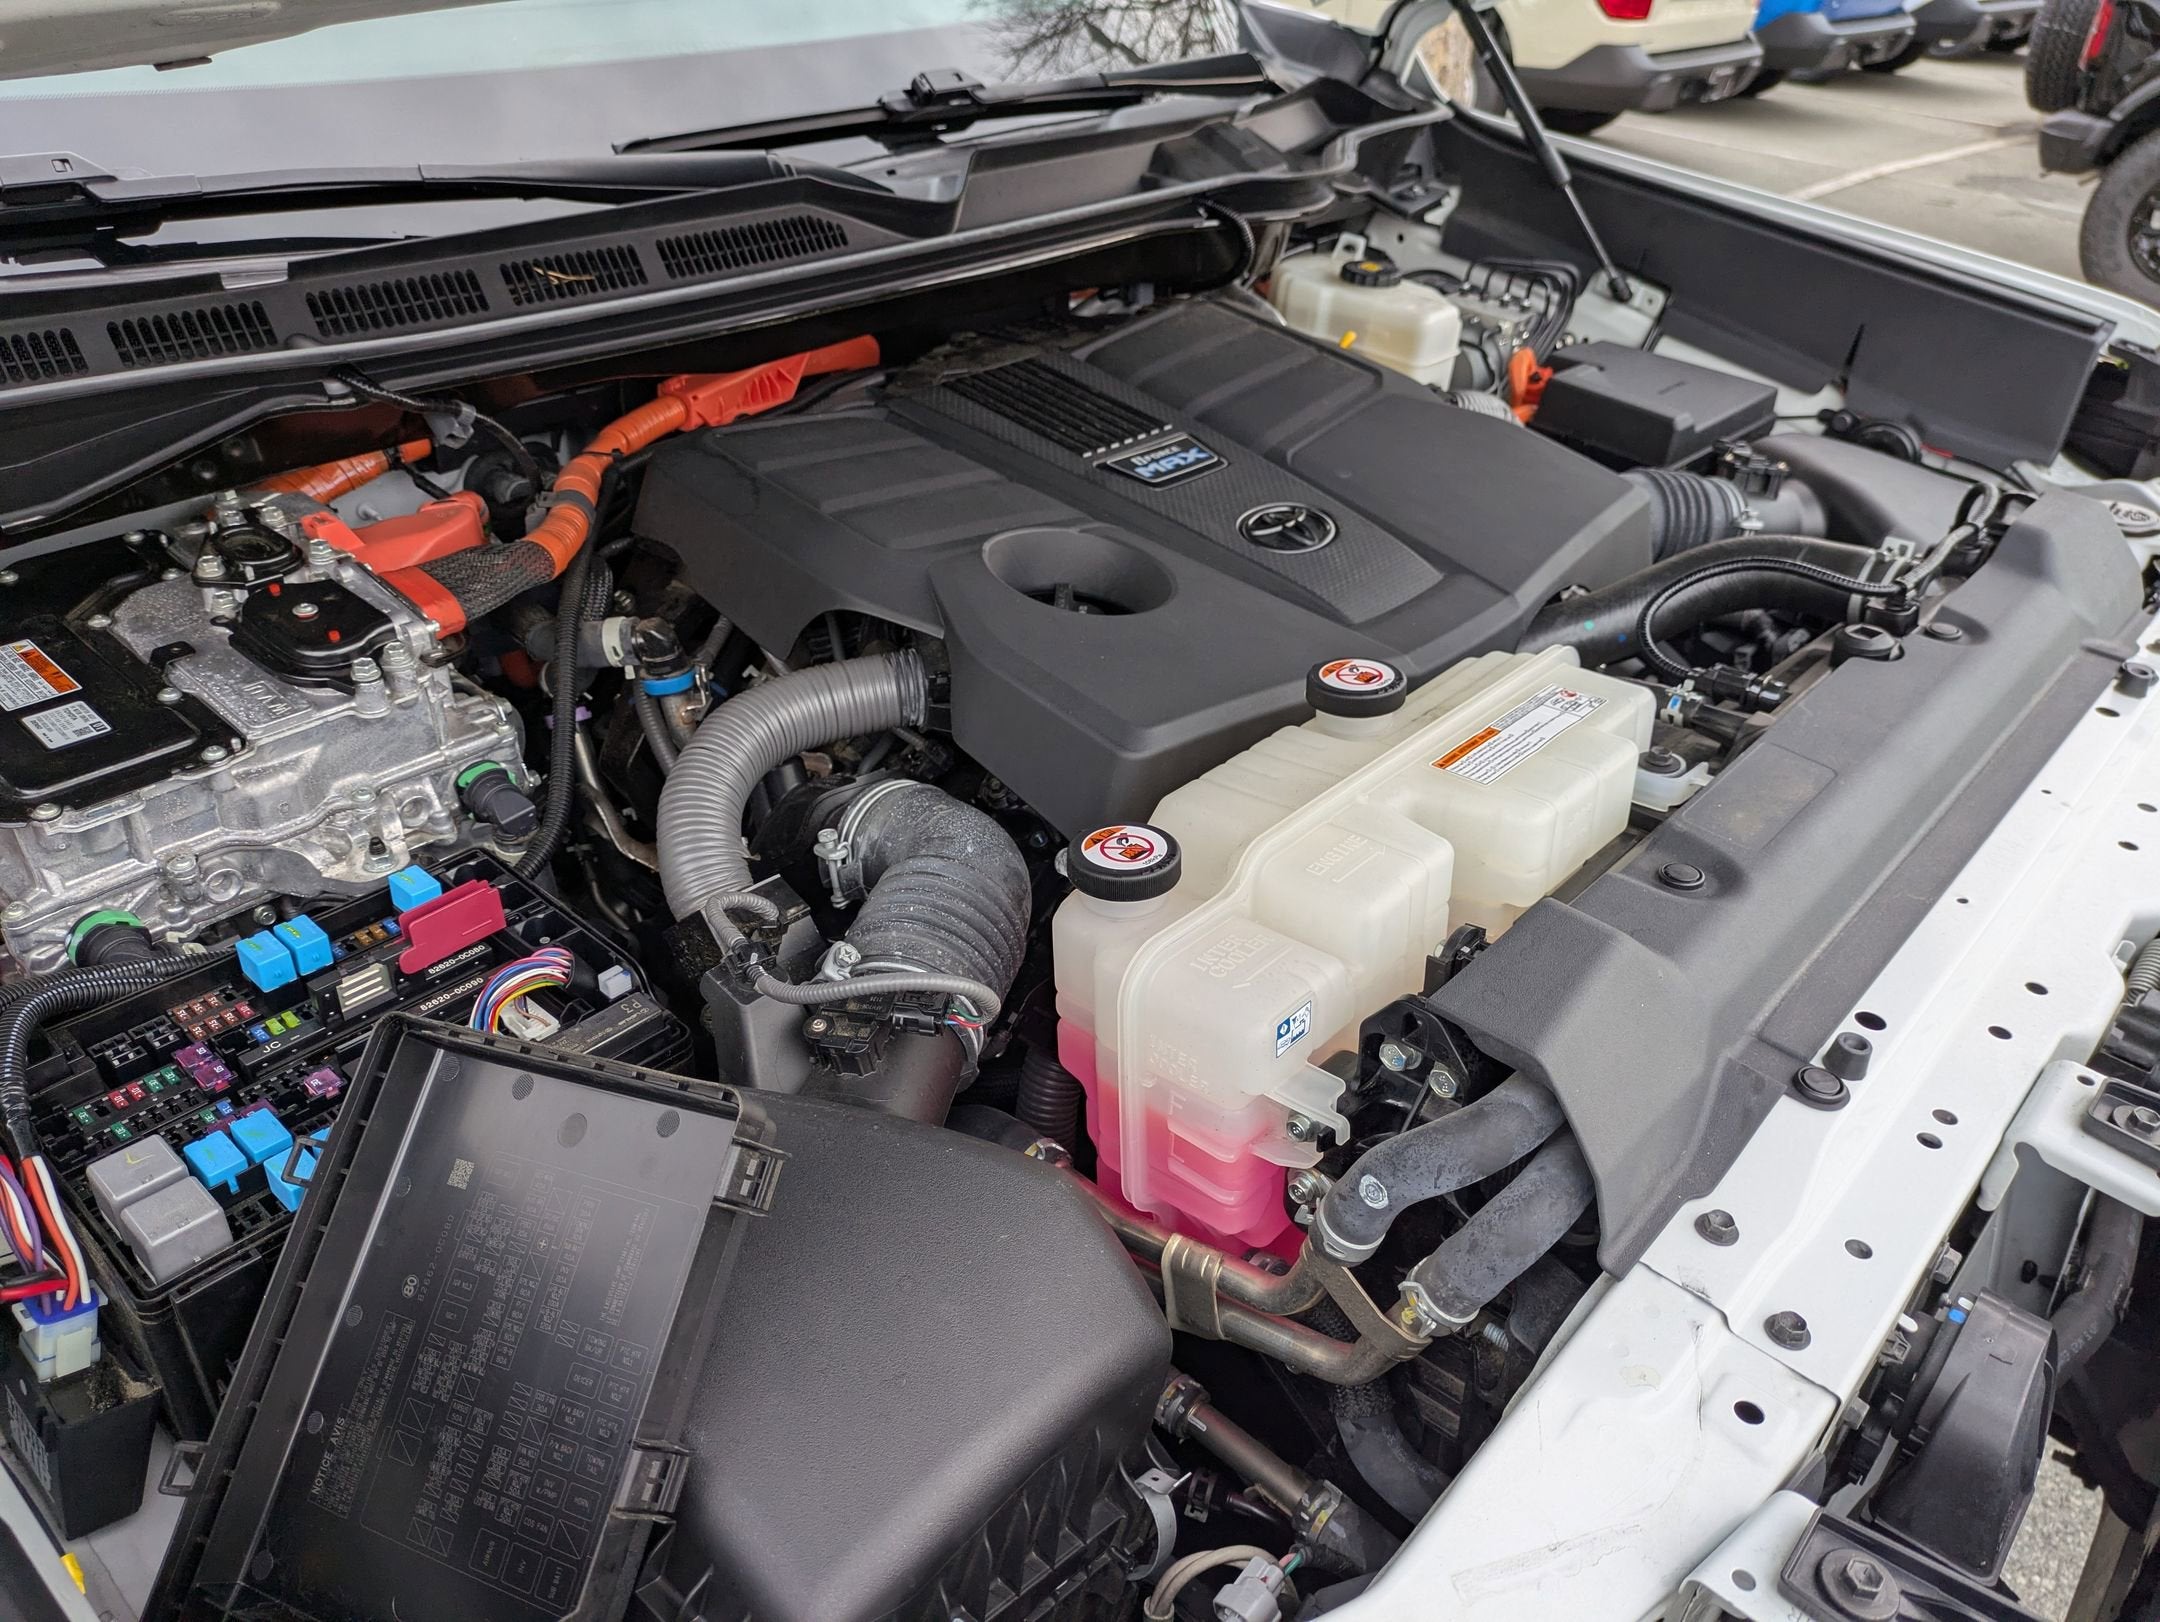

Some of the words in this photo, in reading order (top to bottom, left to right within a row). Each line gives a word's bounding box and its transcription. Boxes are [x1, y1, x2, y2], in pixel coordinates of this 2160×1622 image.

[1134, 447, 1210, 478] MAX
[1306, 834, 1368, 876] ENGINE
[262, 1041, 282, 1054] JC
[402, 1274, 418, 1297] 80
[311, 1449, 334, 1496] NOTICE
[329, 1413, 346, 1446] AVIS
